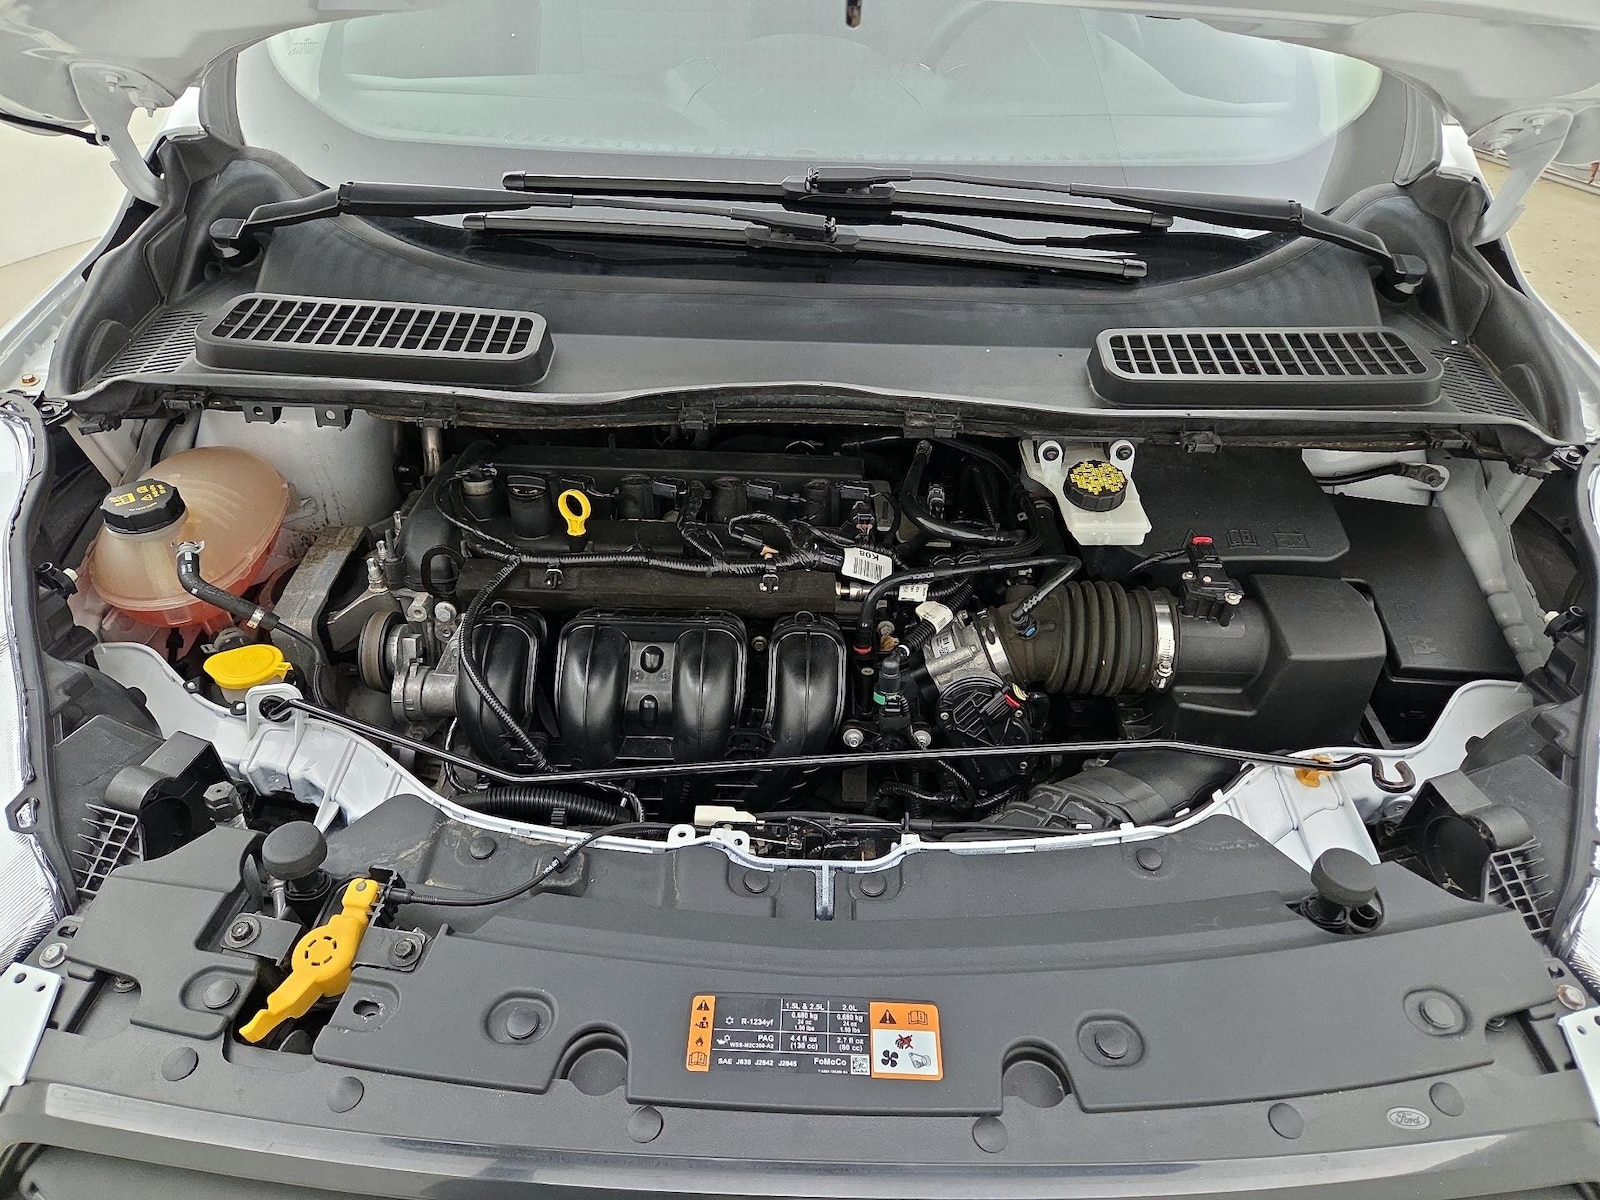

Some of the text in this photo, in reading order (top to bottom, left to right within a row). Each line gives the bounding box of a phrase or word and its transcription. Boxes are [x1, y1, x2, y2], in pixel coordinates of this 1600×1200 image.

[859, 550, 879, 561] K08
[809, 1012, 818, 1020] kg
[855, 1014, 864, 1022] kg
[741, 1018, 774, 1027] R-1234yf
[757, 1034, 774, 1042] PAG
[790, 1042, 805, 1050] (130
[814, 1057, 847, 1066] FoMoCo
